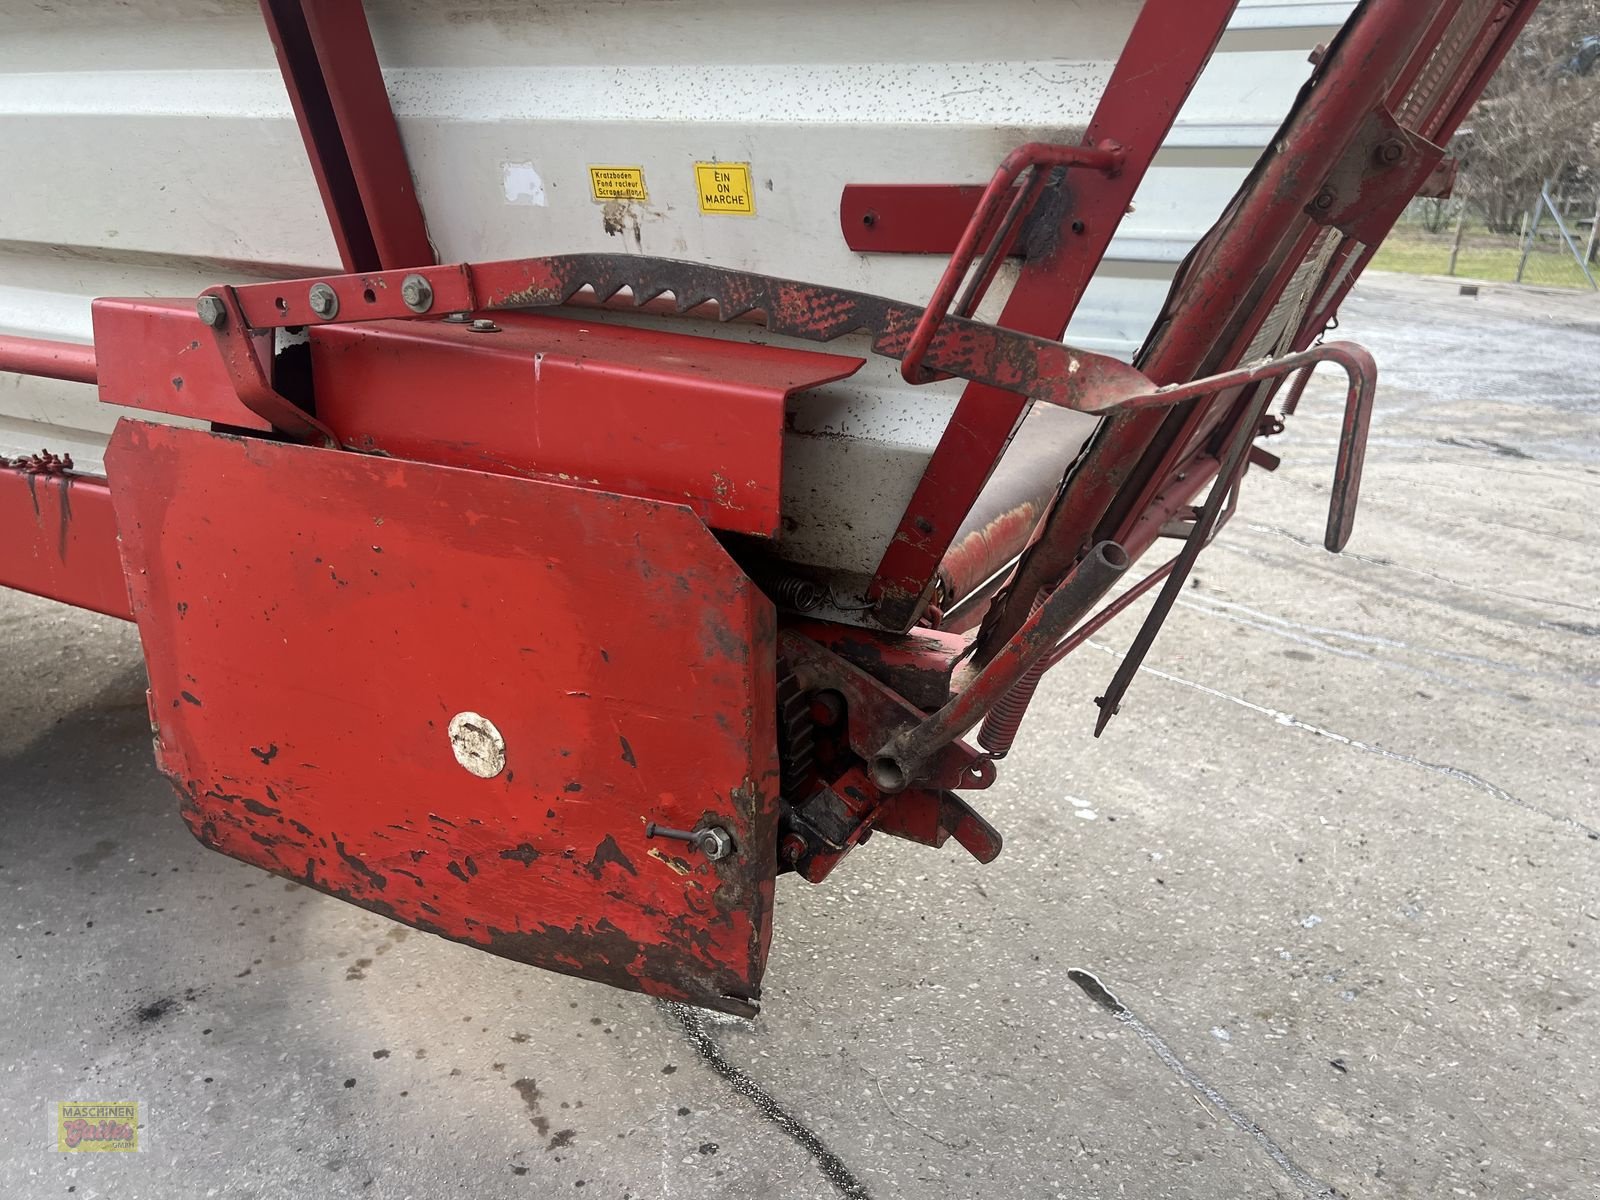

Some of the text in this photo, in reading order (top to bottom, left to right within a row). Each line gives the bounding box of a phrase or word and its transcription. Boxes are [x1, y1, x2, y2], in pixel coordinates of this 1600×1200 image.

[595, 171, 632, 179] Kratzboden
[714, 171, 730, 182] EIN
[615, 180, 638, 188] racleur
[717, 183, 730, 193] ON
[705, 194, 744, 205] MARCHE
